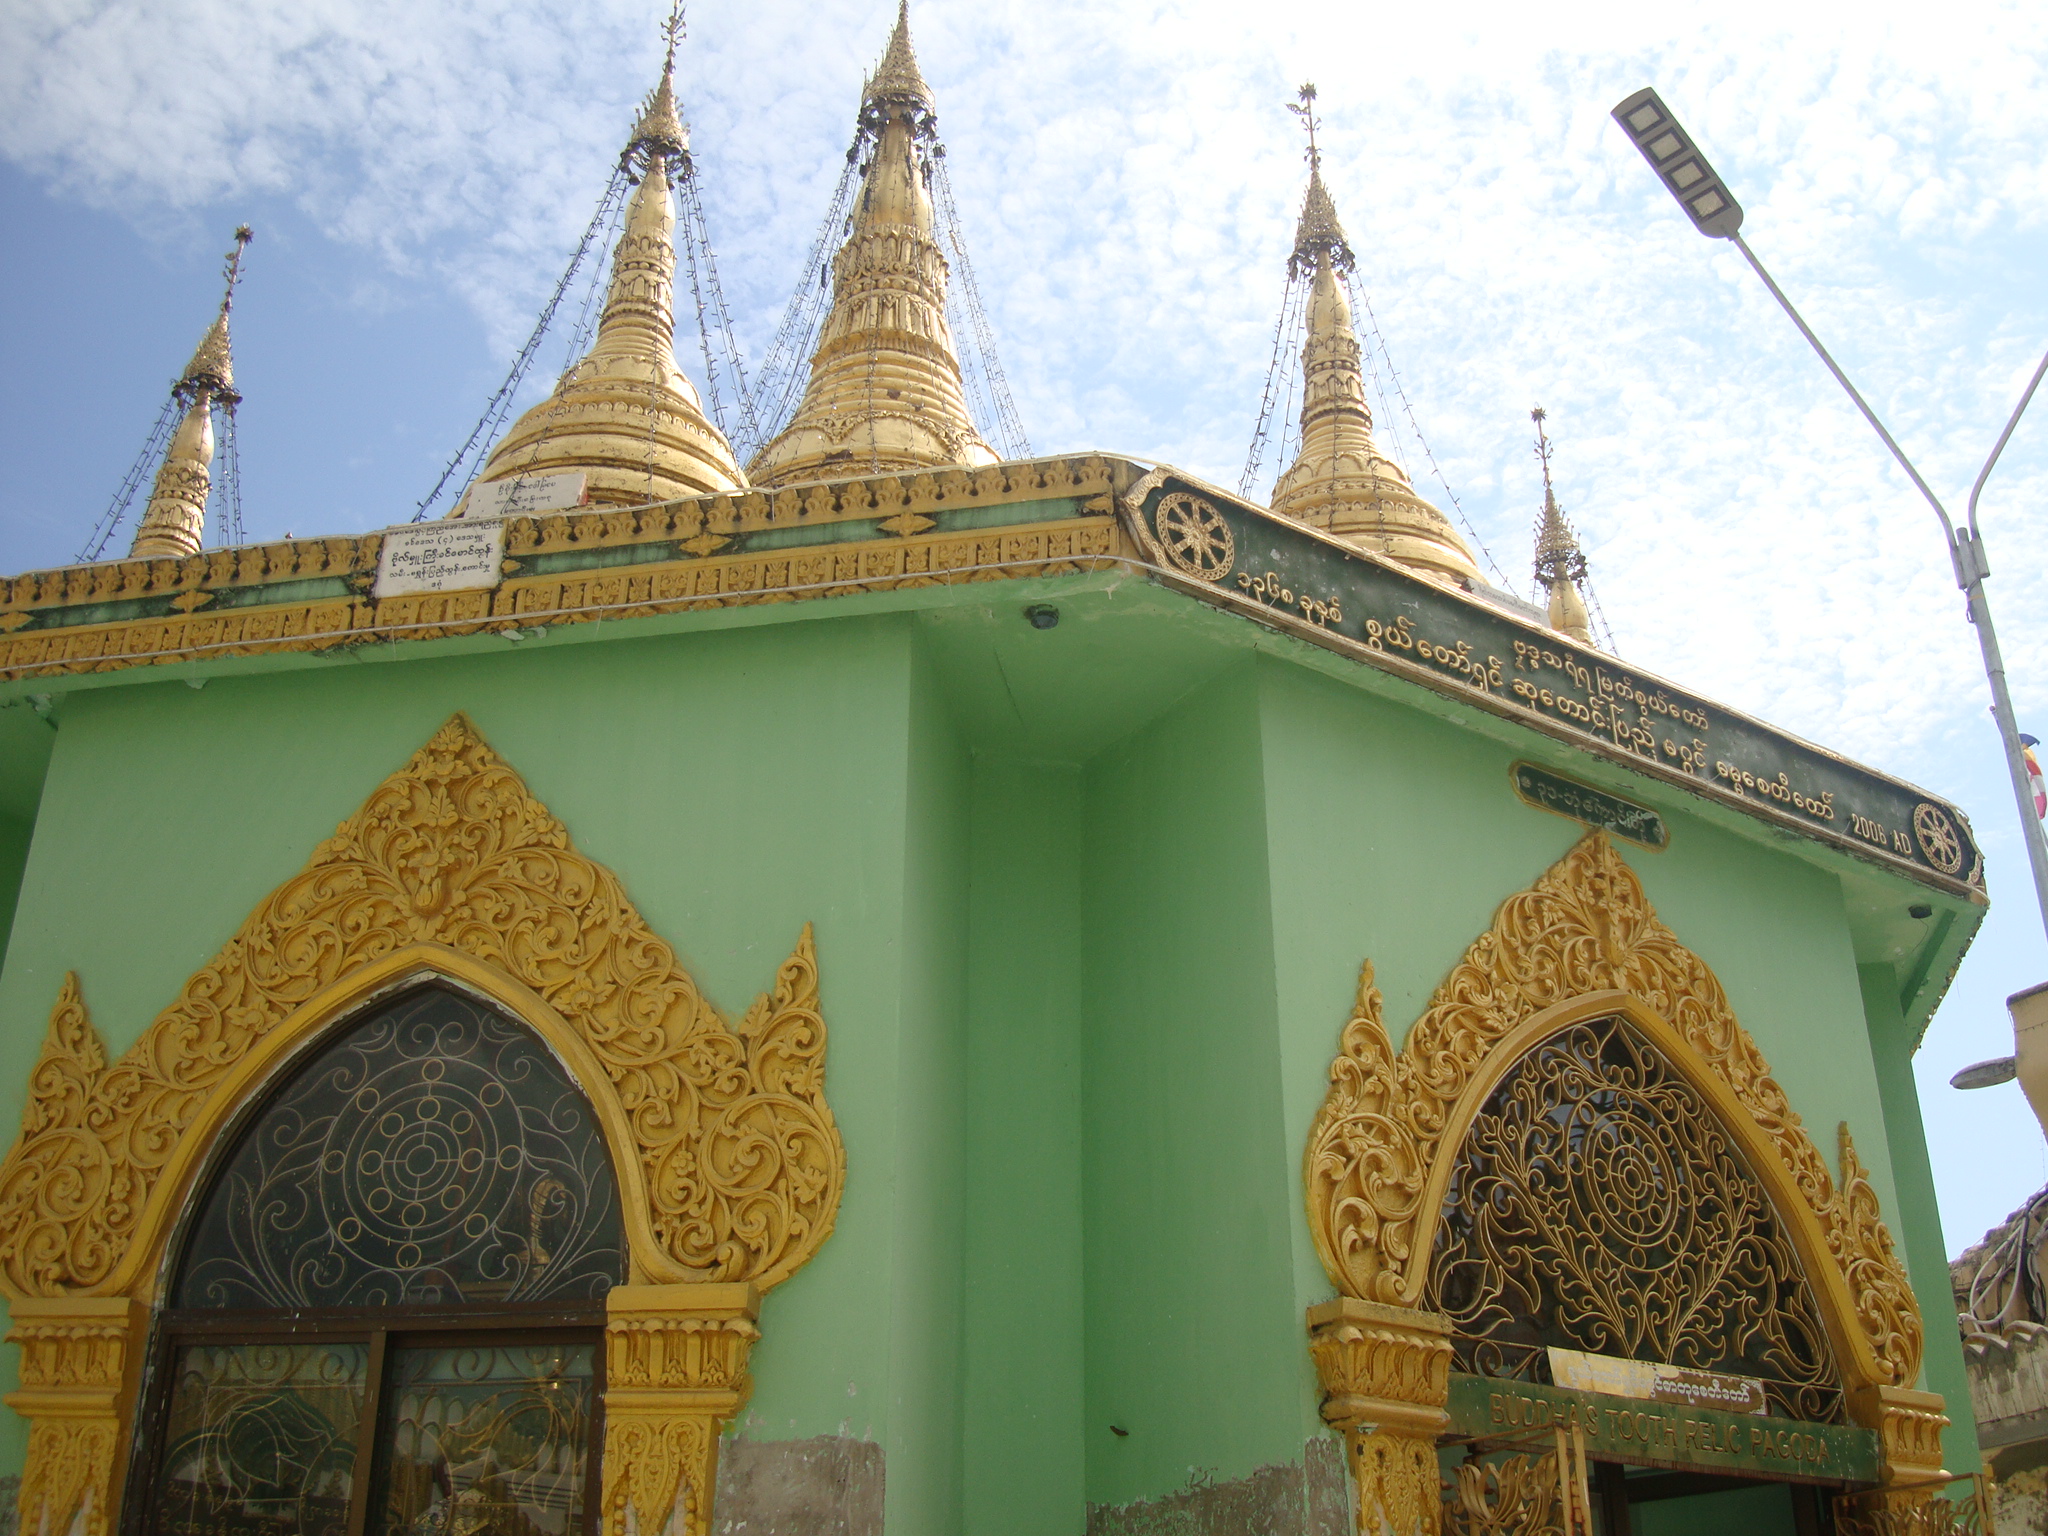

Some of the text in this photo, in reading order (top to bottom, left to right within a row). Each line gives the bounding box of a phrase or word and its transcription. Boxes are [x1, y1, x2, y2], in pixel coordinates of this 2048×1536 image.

[1851, 812, 1888, 846] 2006
[1892, 829, 1912, 855] AD
[1490, 1393, 1830, 1465] BUDDHA'S TOOTH RELIC PAGODA
